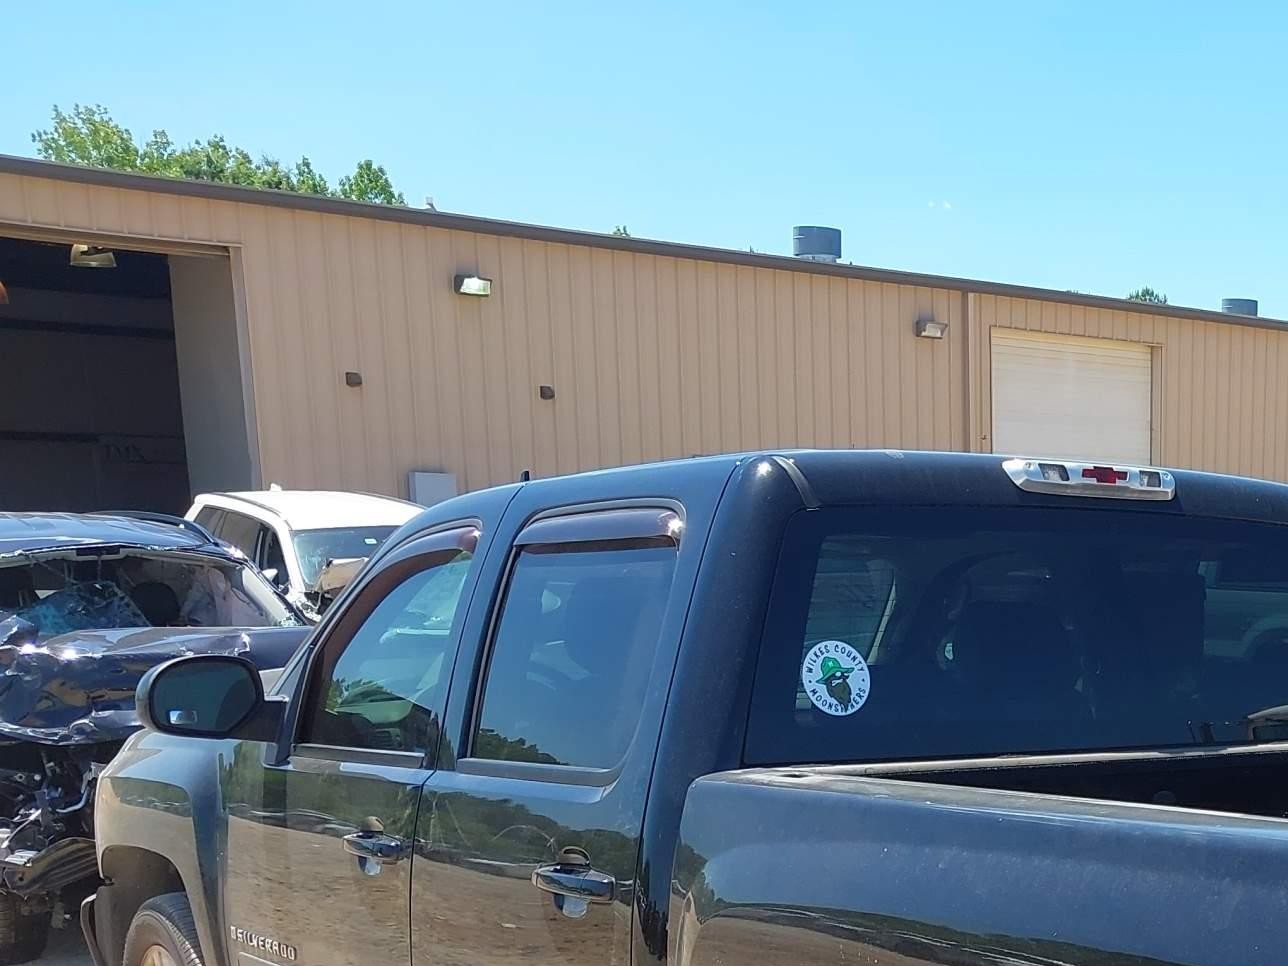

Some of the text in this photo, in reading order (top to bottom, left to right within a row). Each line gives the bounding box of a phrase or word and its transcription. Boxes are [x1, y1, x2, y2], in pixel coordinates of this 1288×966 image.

[805, 644, 865, 674] WILKES COUNTY
[236, 927, 298, 961] SILVERADO
